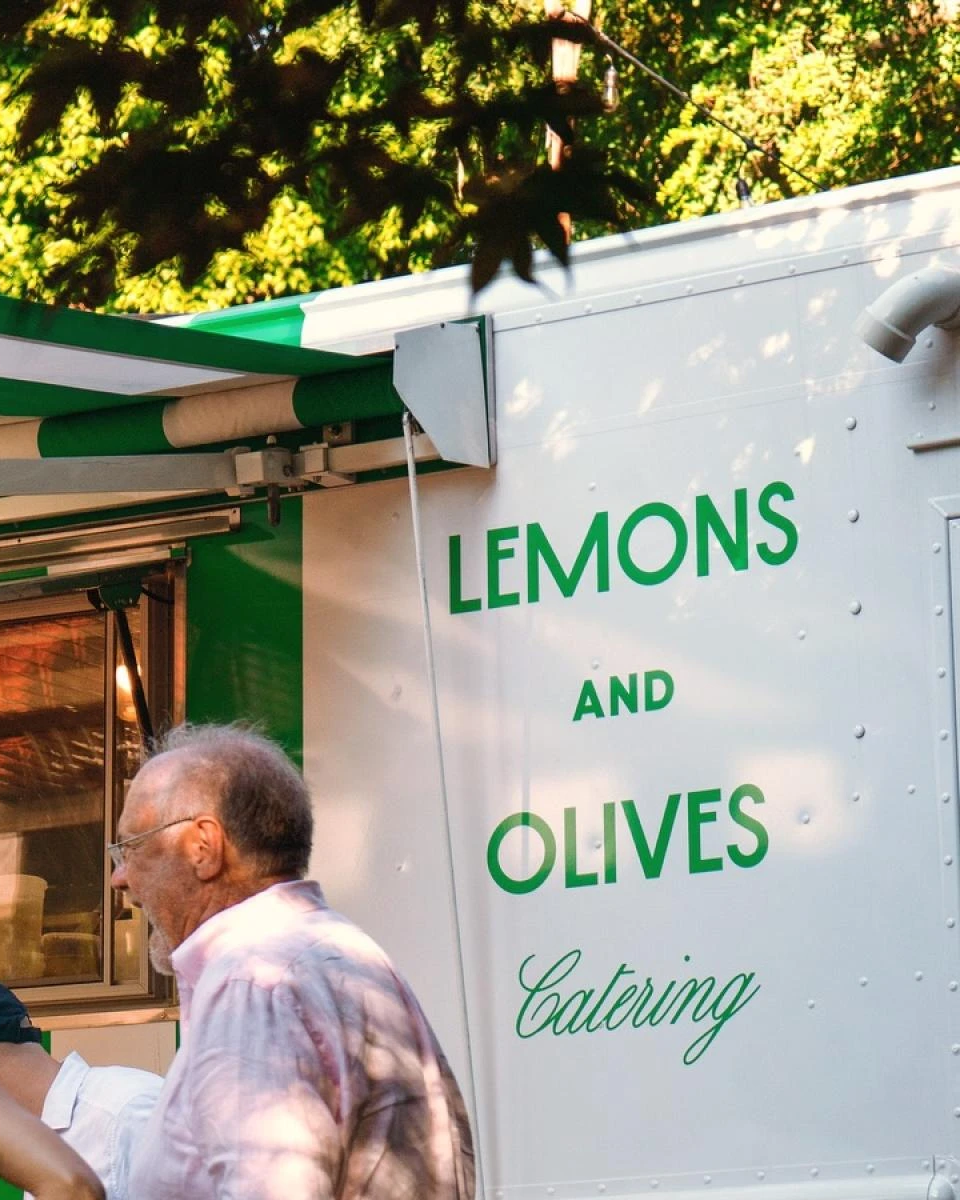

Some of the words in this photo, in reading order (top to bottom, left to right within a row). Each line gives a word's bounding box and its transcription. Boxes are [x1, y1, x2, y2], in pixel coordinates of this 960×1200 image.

[449, 480, 800, 615] LEMONS
[572, 670, 675, 722] AND
[486, 784, 769, 895] OLIVES
[515, 949, 760, 1066] Catering
